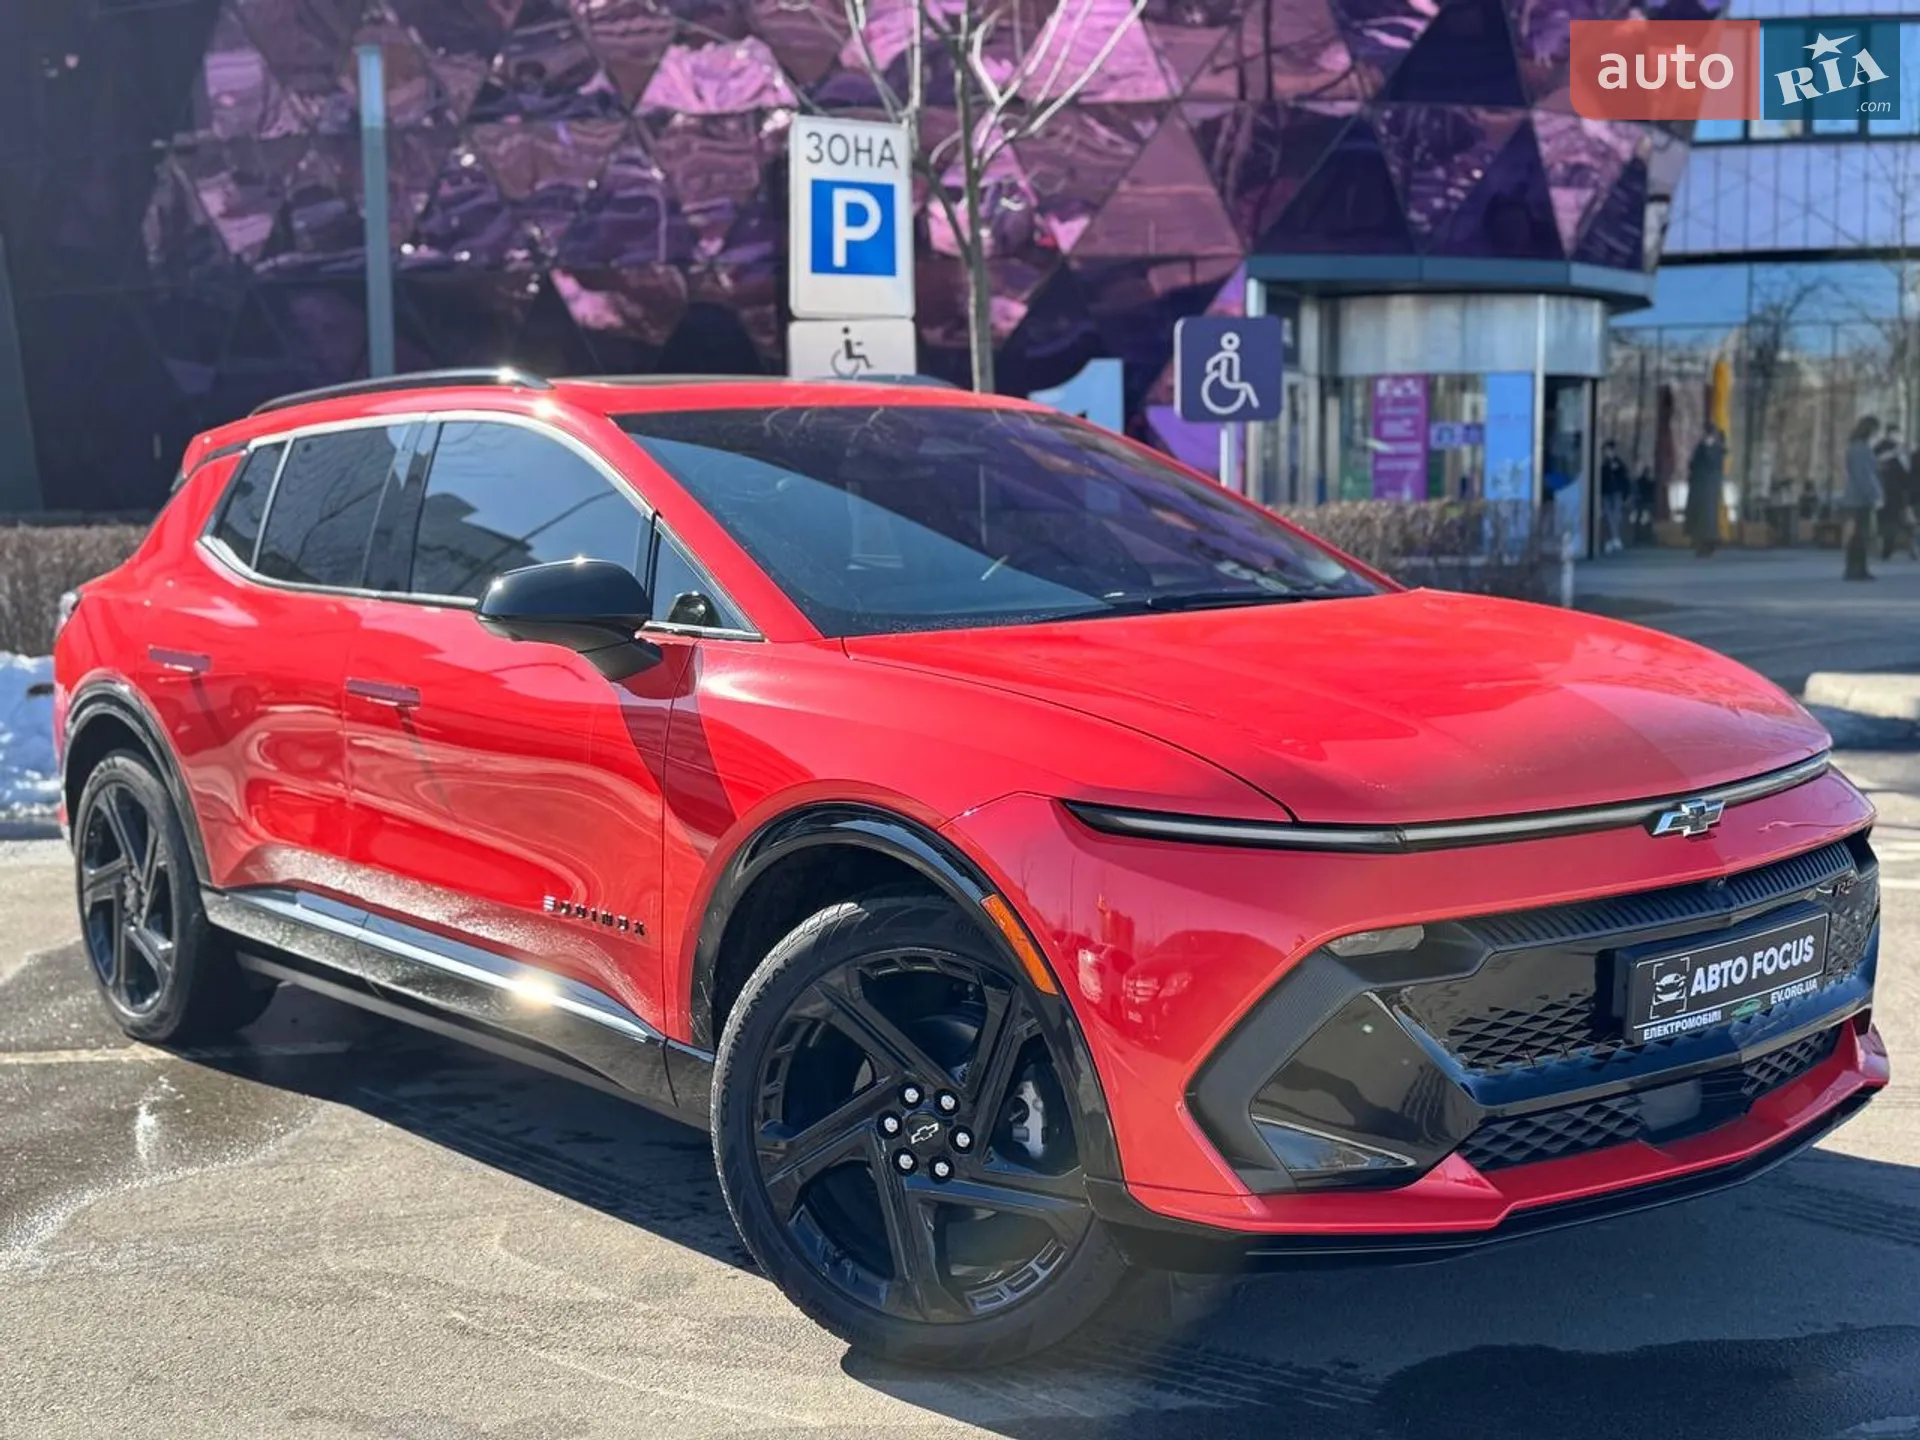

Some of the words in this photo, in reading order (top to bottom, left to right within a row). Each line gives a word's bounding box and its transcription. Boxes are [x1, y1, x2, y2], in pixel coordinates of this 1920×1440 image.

[806, 132, 899, 169] ЗОНА
[832, 187, 882, 268] P
[1690, 956, 1748, 997] АВТО
[1752, 934, 1815, 980] FOCUS
[1770, 979, 1818, 1005] EV.ORG.UA
[1643, 1010, 1722, 1041] ЕЛЕКТРОМОБІЛІ
